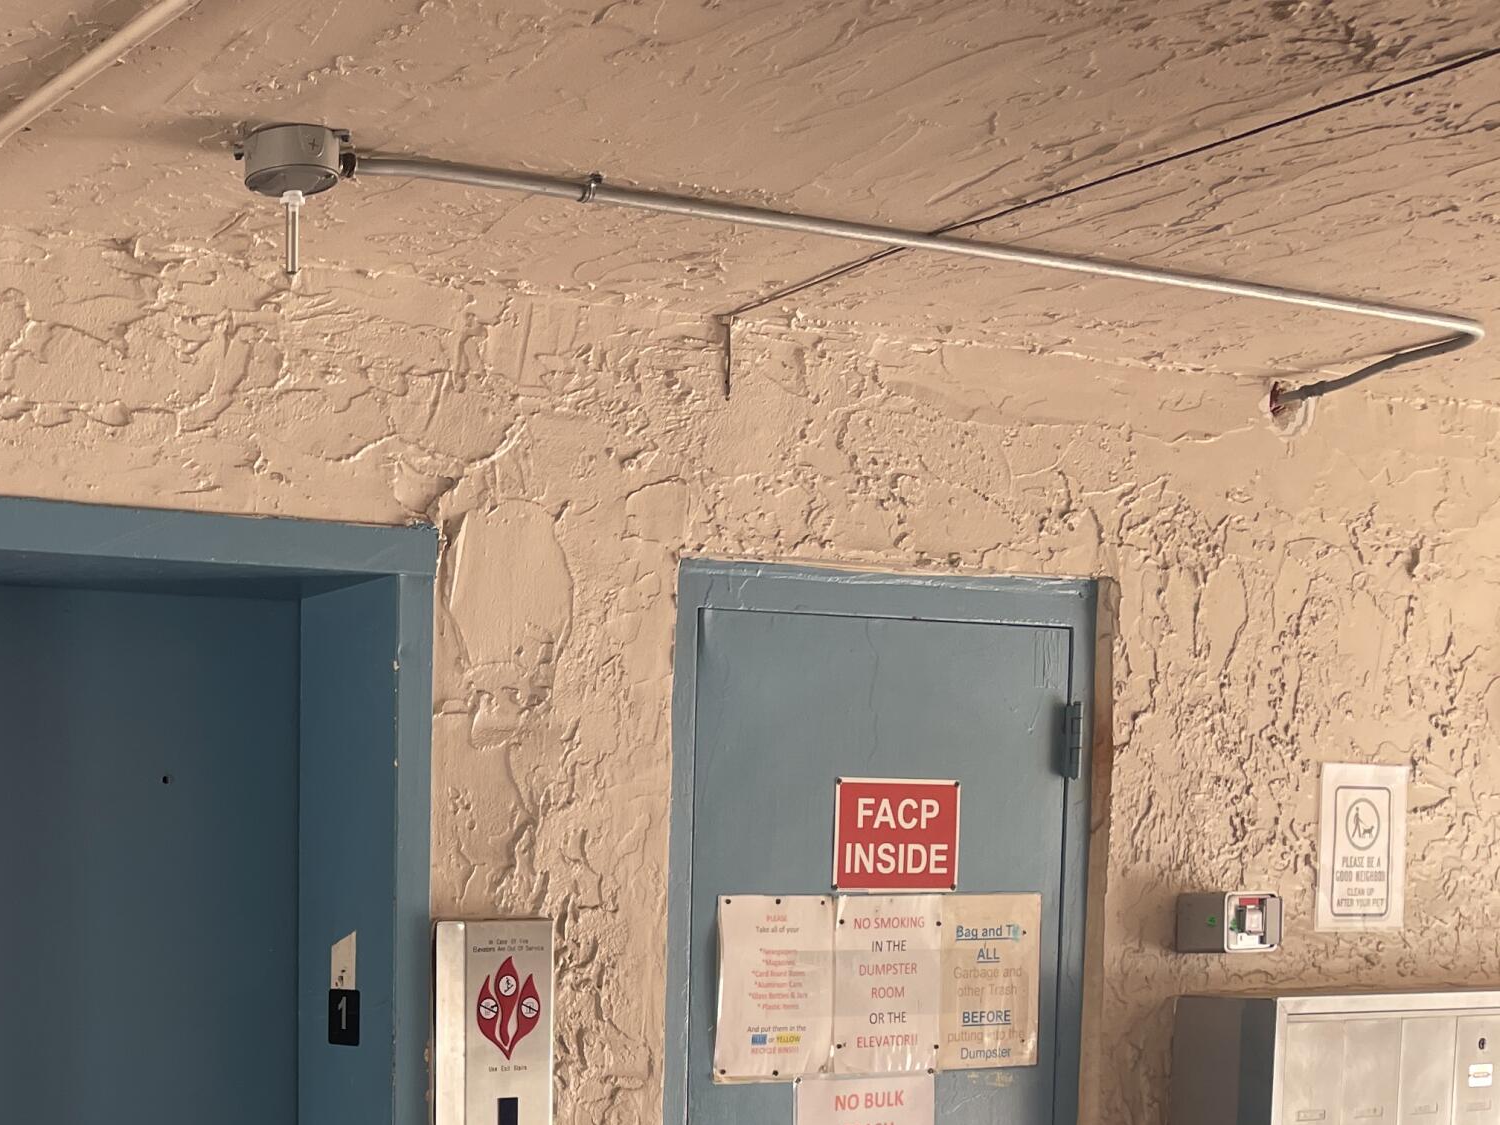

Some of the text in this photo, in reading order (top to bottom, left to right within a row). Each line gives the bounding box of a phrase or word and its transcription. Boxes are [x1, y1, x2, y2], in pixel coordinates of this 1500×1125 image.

[857, 798, 940, 829] FACP
[845, 843, 948, 874] INSIDE
[1342, 856, 1380, 868] PLEASE BE A
[1336, 871, 1352, 881] GOOD
[1347, 888, 1374, 896] CLEAN UP
[1337, 898, 1384, 907] AFTER YOUR PET
[854, 916, 925, 929] NO SMOKING
[956, 925, 978, 939] Bag
[982, 926, 1003, 937] and
[872, 940, 907, 952] IN THE
[977, 948, 1000, 961] ALL
[859, 963, 917, 976] DUMPSTER
[954, 966, 1022, 981] Garbage and
[871, 987, 905, 999] ROOM
[957, 983, 1017, 997] other Trash
[337, 996, 347, 1030] 1
[869, 1012, 907, 1025] OR THE
[963, 1010, 1011, 1024] BEFORE
[761, 1025, 771, 1034] put
[947, 1031, 982, 1045] putting
[961, 1048, 1011, 1061] Dumpster
[835, 1090, 904, 1112] NO BULK
